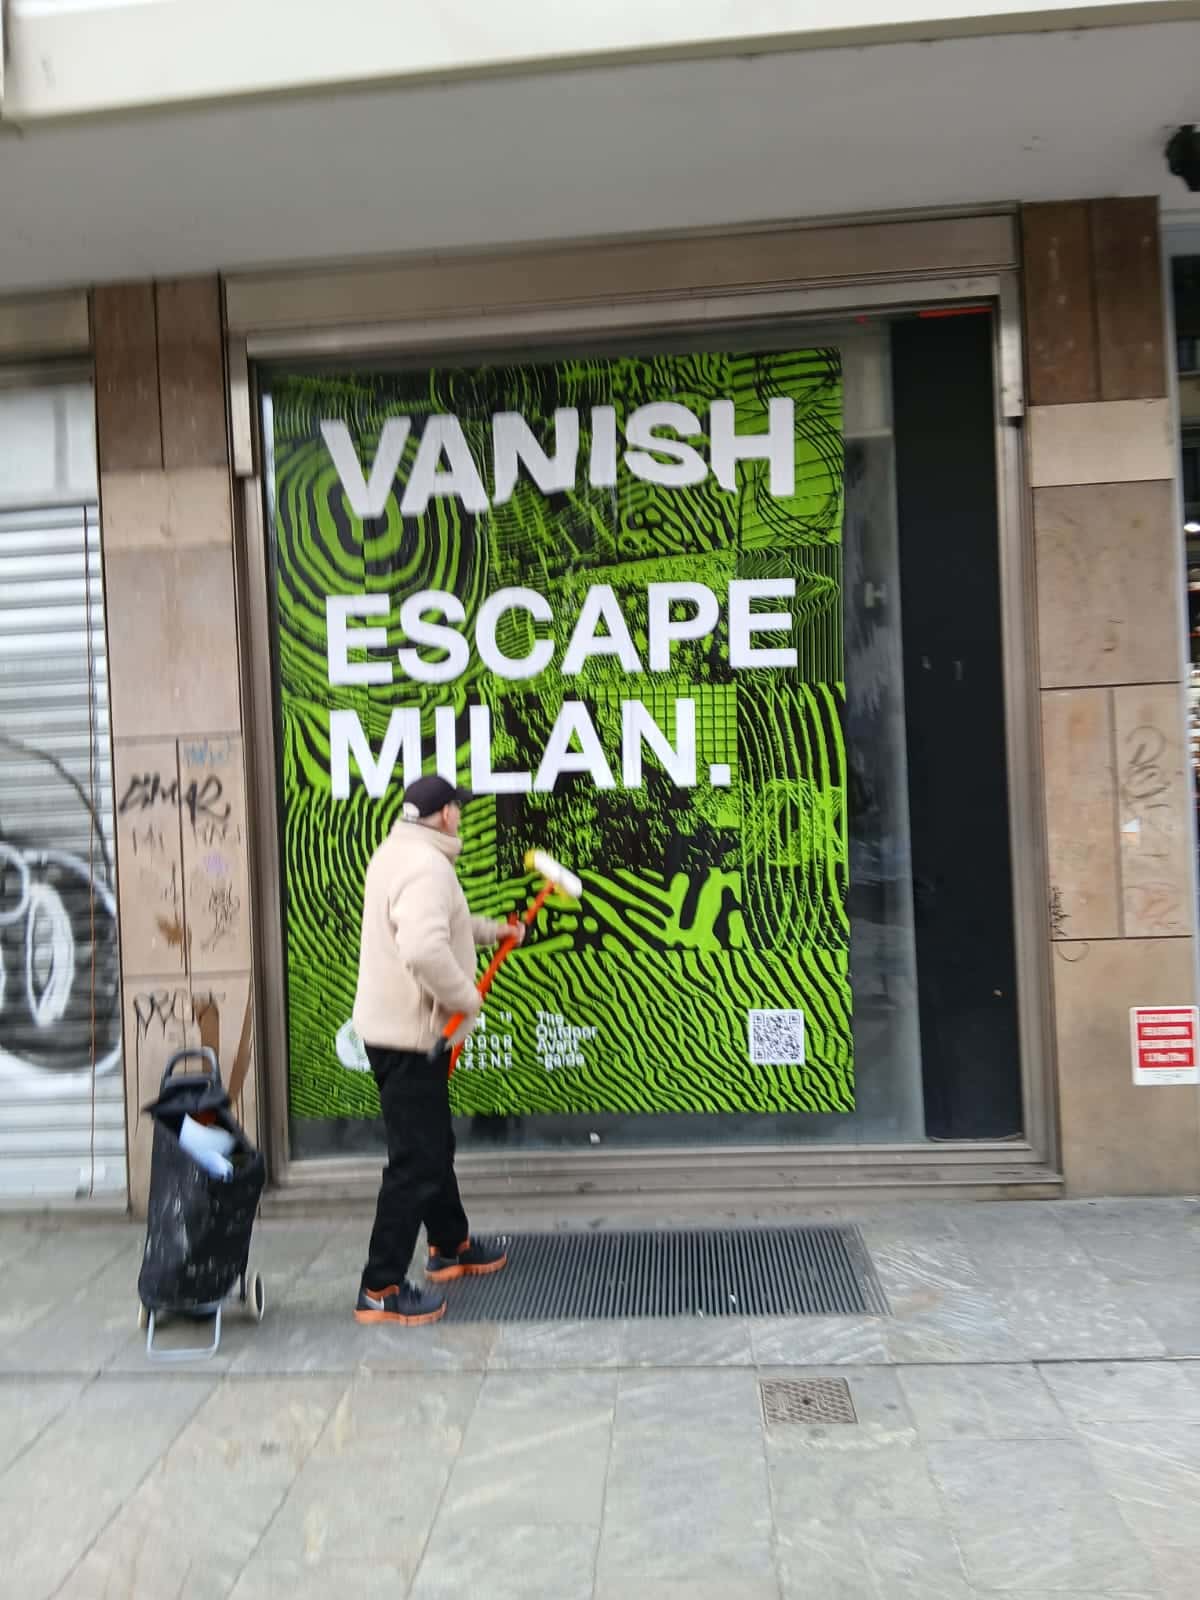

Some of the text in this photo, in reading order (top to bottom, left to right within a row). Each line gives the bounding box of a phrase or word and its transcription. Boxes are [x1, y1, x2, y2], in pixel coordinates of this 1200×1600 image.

[321, 397, 795, 518] VANISH
[325, 578, 798, 686] ESCAPE
[329, 699, 731, 801] MILAN.
[535, 1010, 564, 1025] The
